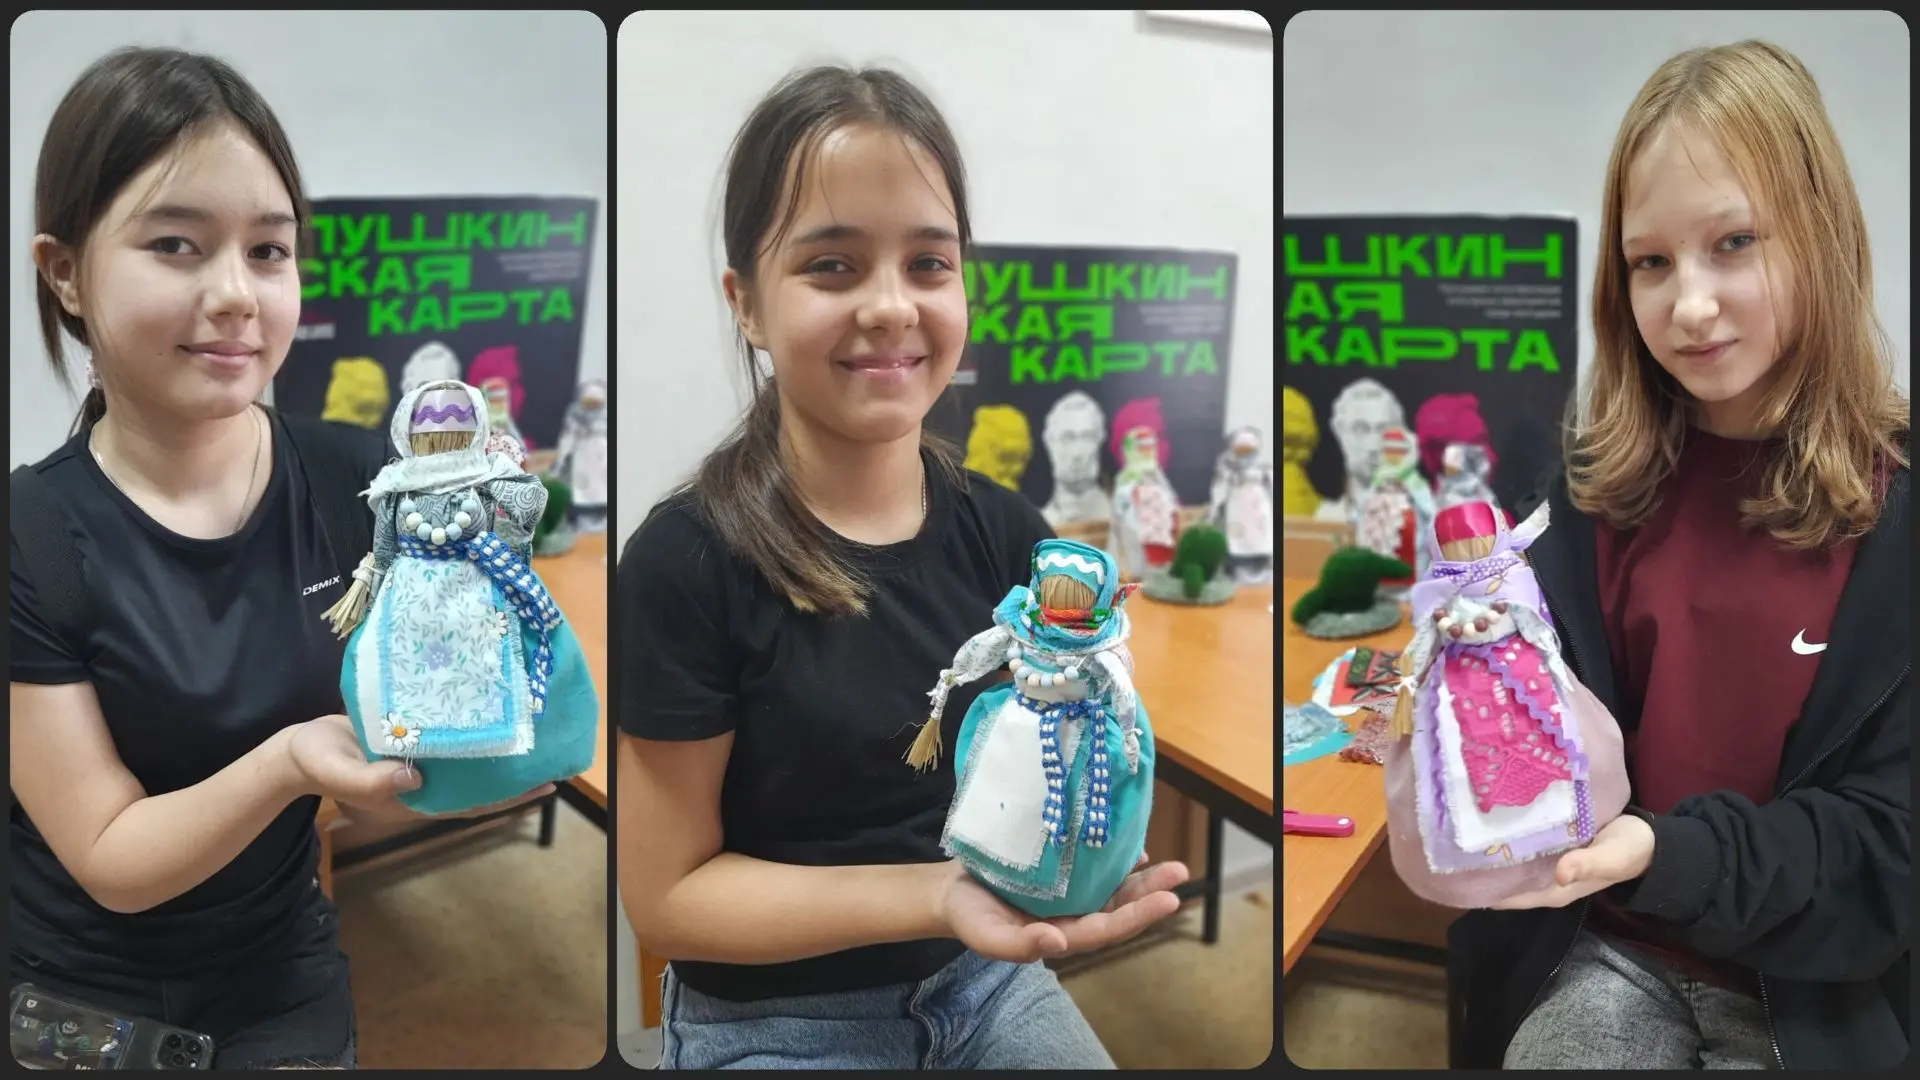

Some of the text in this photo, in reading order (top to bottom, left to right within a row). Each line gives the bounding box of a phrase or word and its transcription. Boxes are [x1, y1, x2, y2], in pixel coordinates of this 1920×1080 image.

[1283, 233, 1563, 278] ШКИН
[367, 287, 576, 336] КАРТА
[1285, 281, 1405, 322] АЯ
[1010, 339, 1219, 383] КАРТА
[1285, 325, 1561, 372] КАРТА
[302, 575, 340, 596] DEMIX
